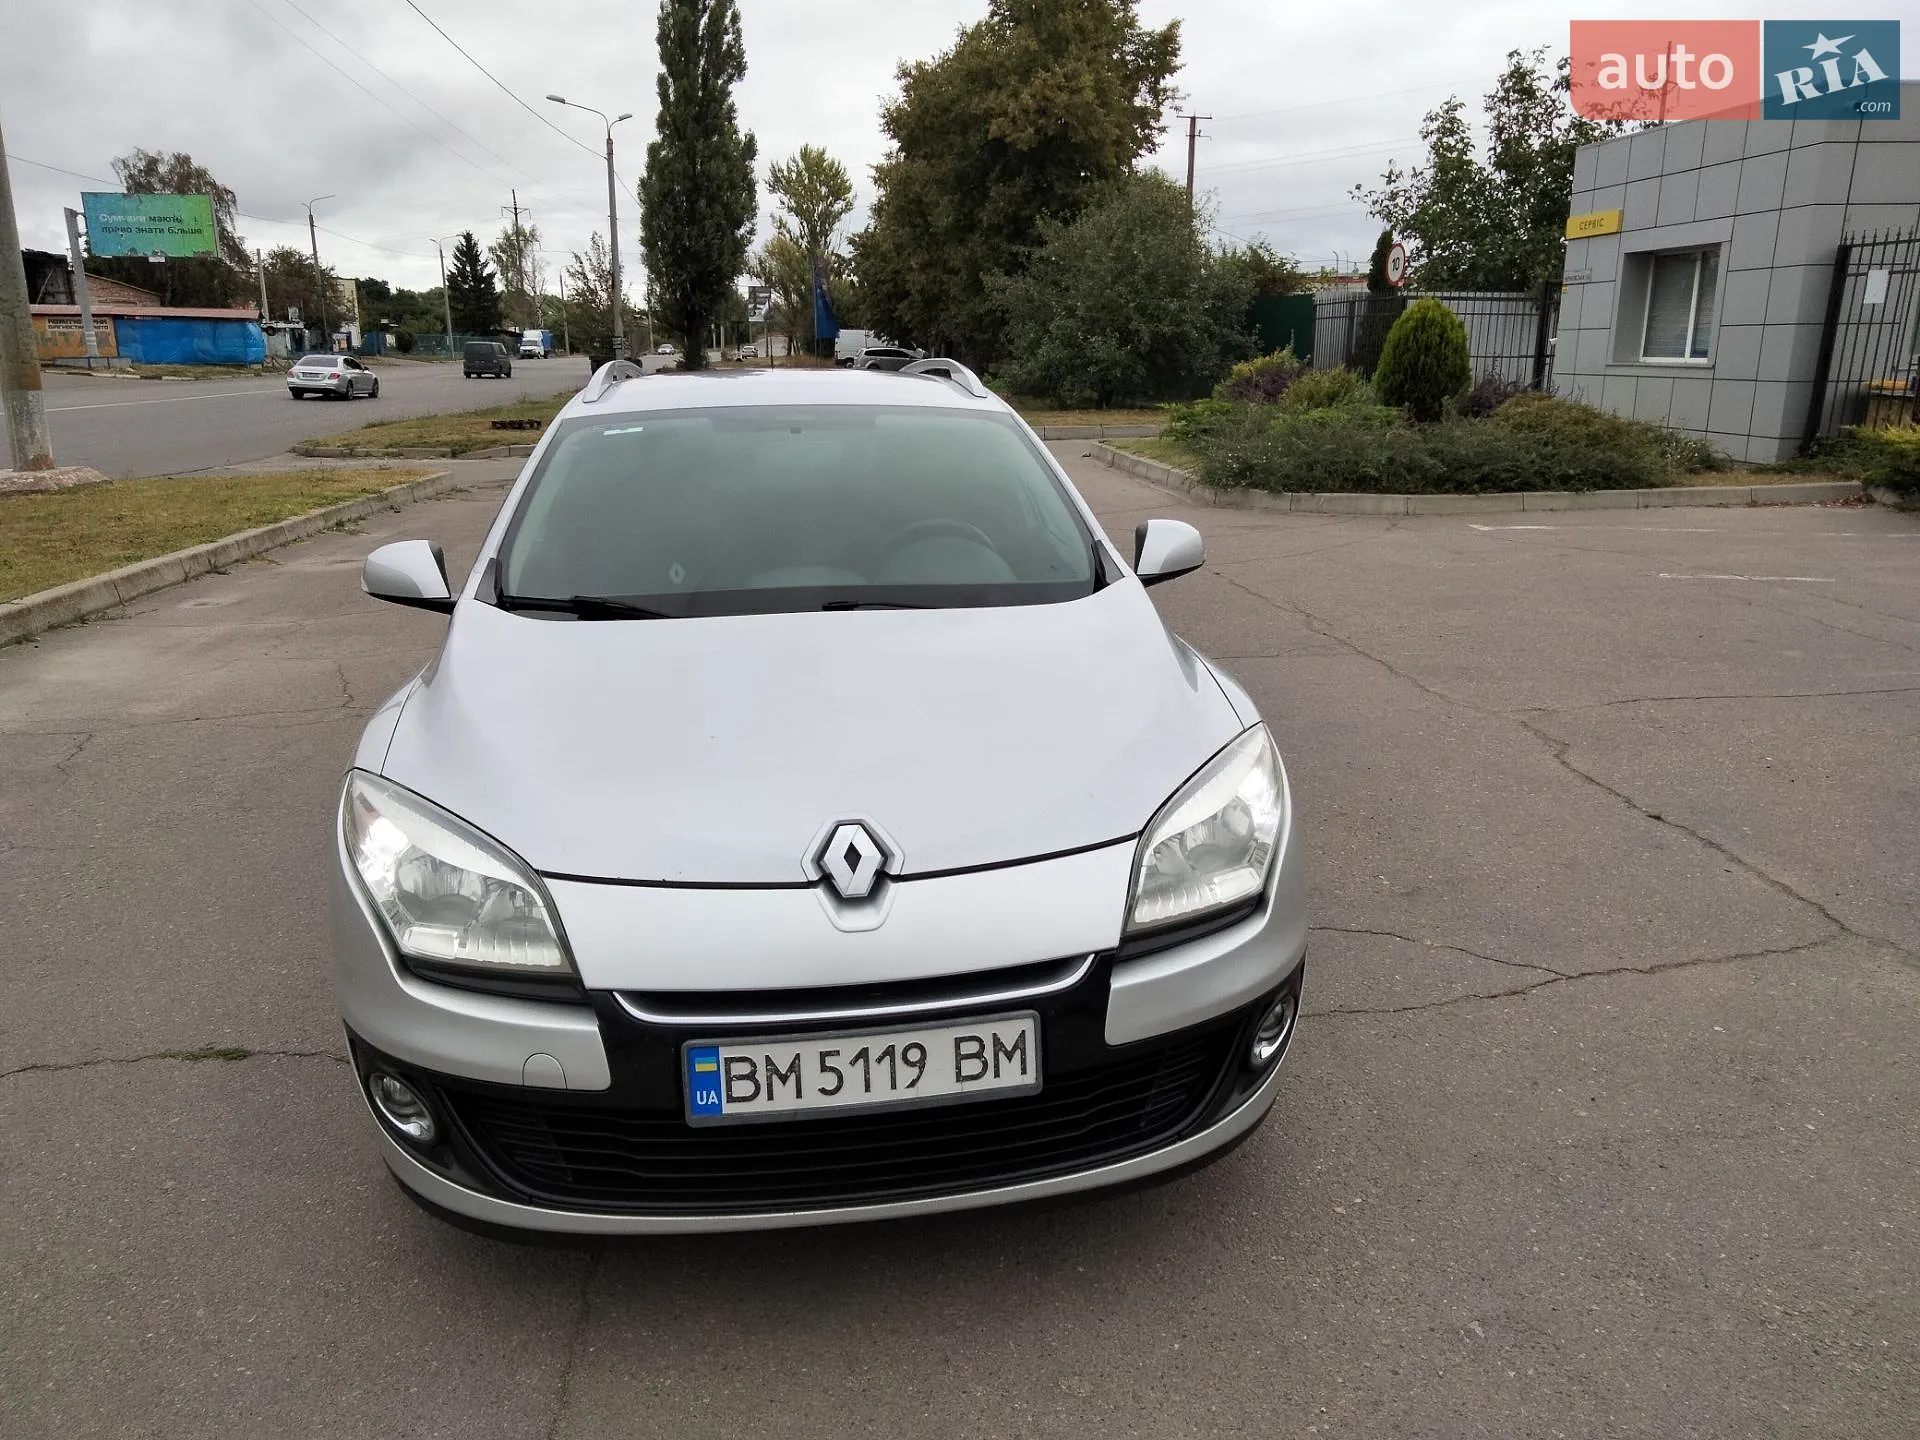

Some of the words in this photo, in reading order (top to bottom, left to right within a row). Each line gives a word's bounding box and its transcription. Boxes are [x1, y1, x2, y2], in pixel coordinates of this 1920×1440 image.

[135, 226, 166, 235] знати
[1391, 256, 1400, 272] 10
[723, 1052, 803, 1104] BM
[817, 1041, 928, 1096] 5119
[953, 1029, 1028, 1084] BM
[696, 1090, 719, 1106] UA
